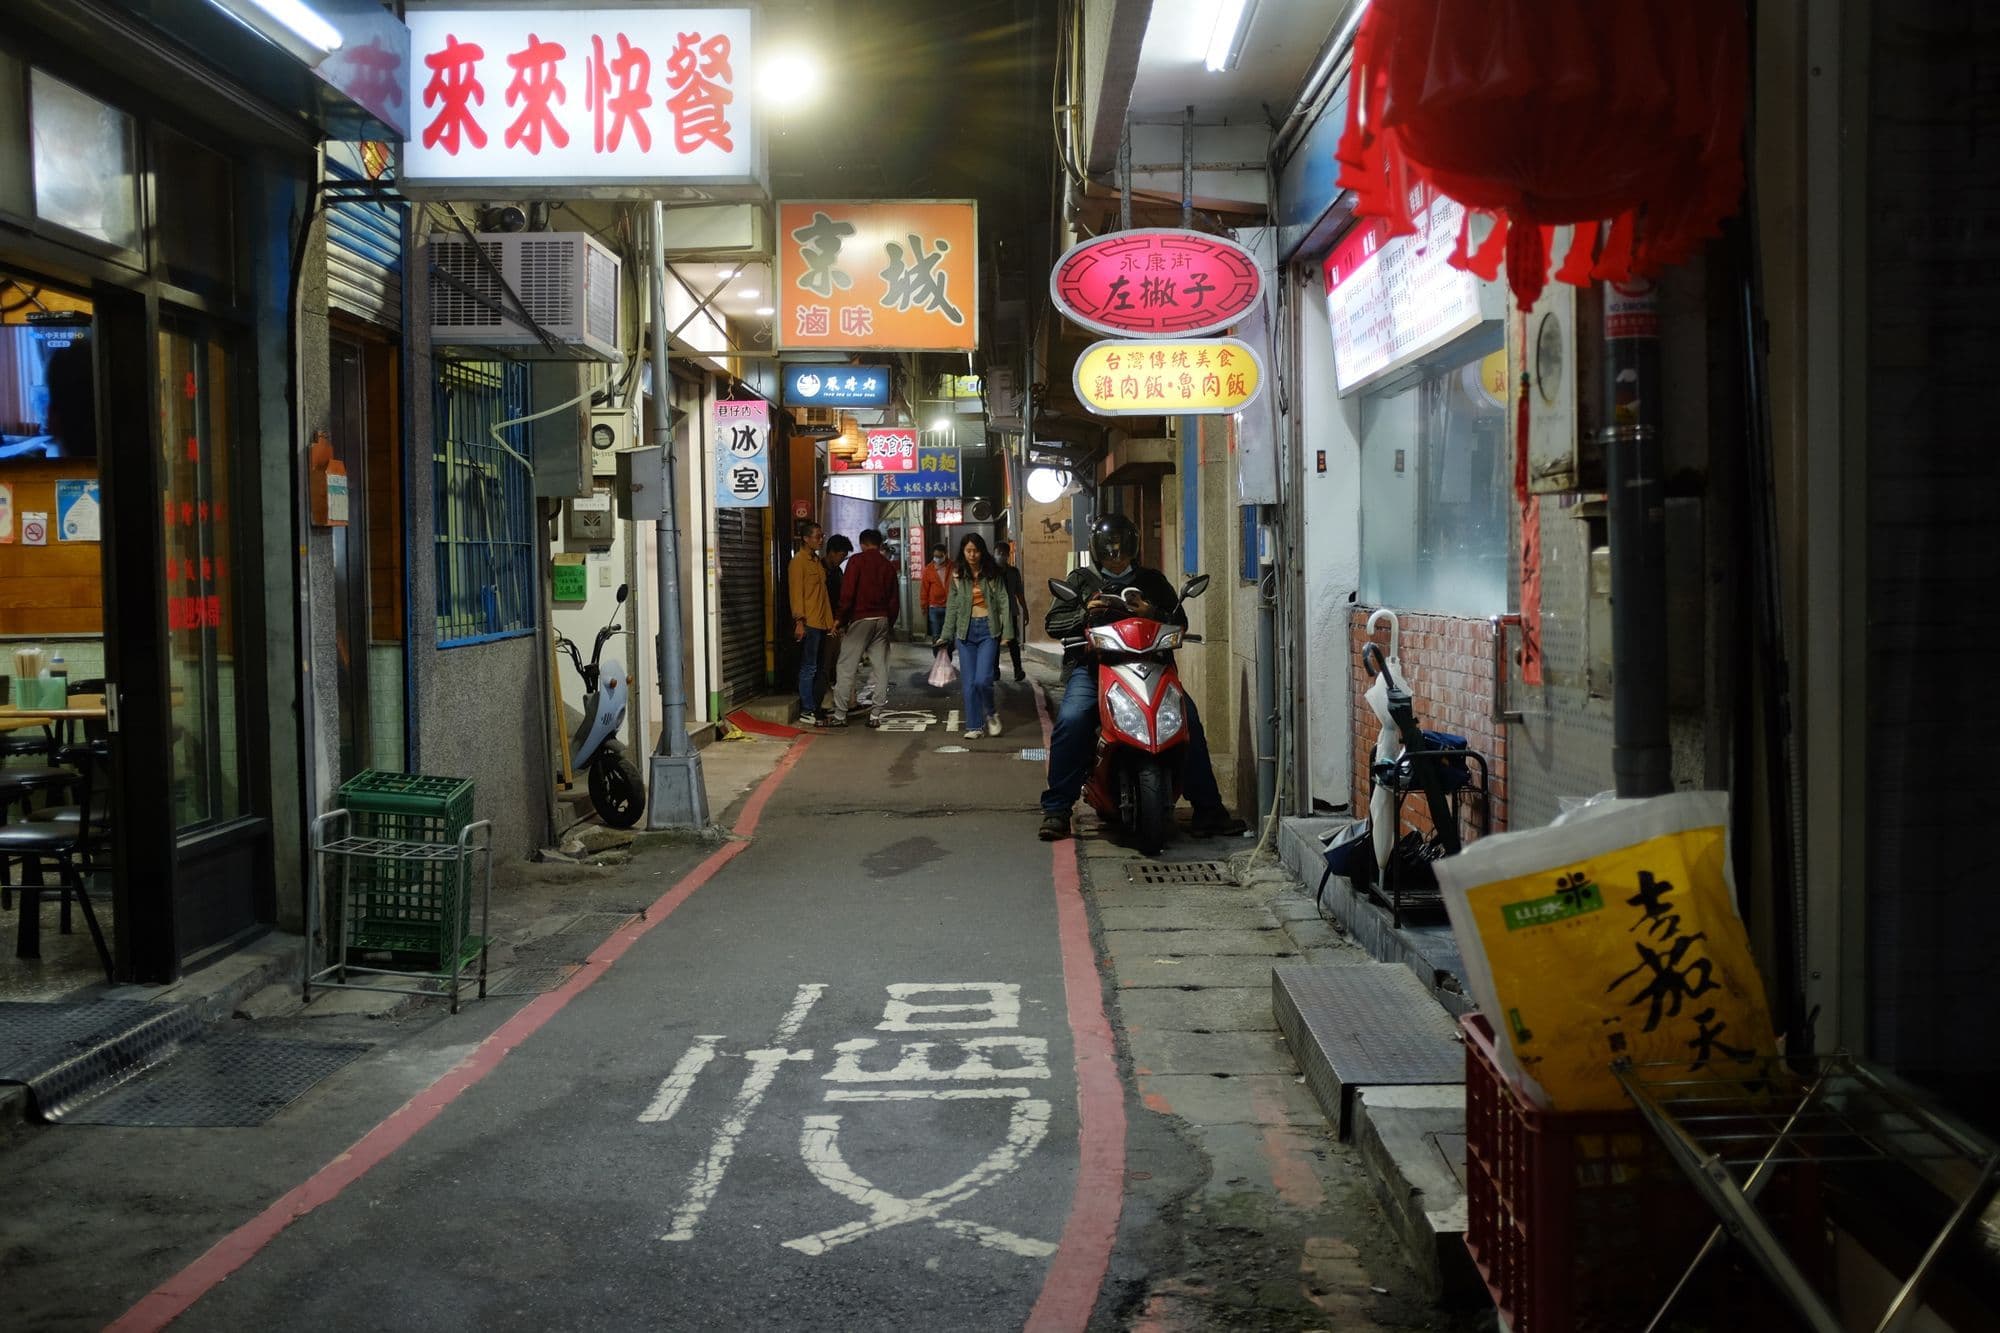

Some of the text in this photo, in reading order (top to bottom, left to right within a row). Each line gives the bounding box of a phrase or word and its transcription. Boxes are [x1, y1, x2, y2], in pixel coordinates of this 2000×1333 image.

[423, 32, 734, 156] 來來快餐
[792, 212, 965, 325] 京城
[1119, 252, 1193, 273] 永康街
[1102, 272, 1216, 312] 左撇子
[797, 305, 873, 336] 滷味
[1105, 348, 1235, 371] 台灣傳統美食
[730, 425, 760, 493] 冰室
[637, 982, 1059, 1256] 慢
